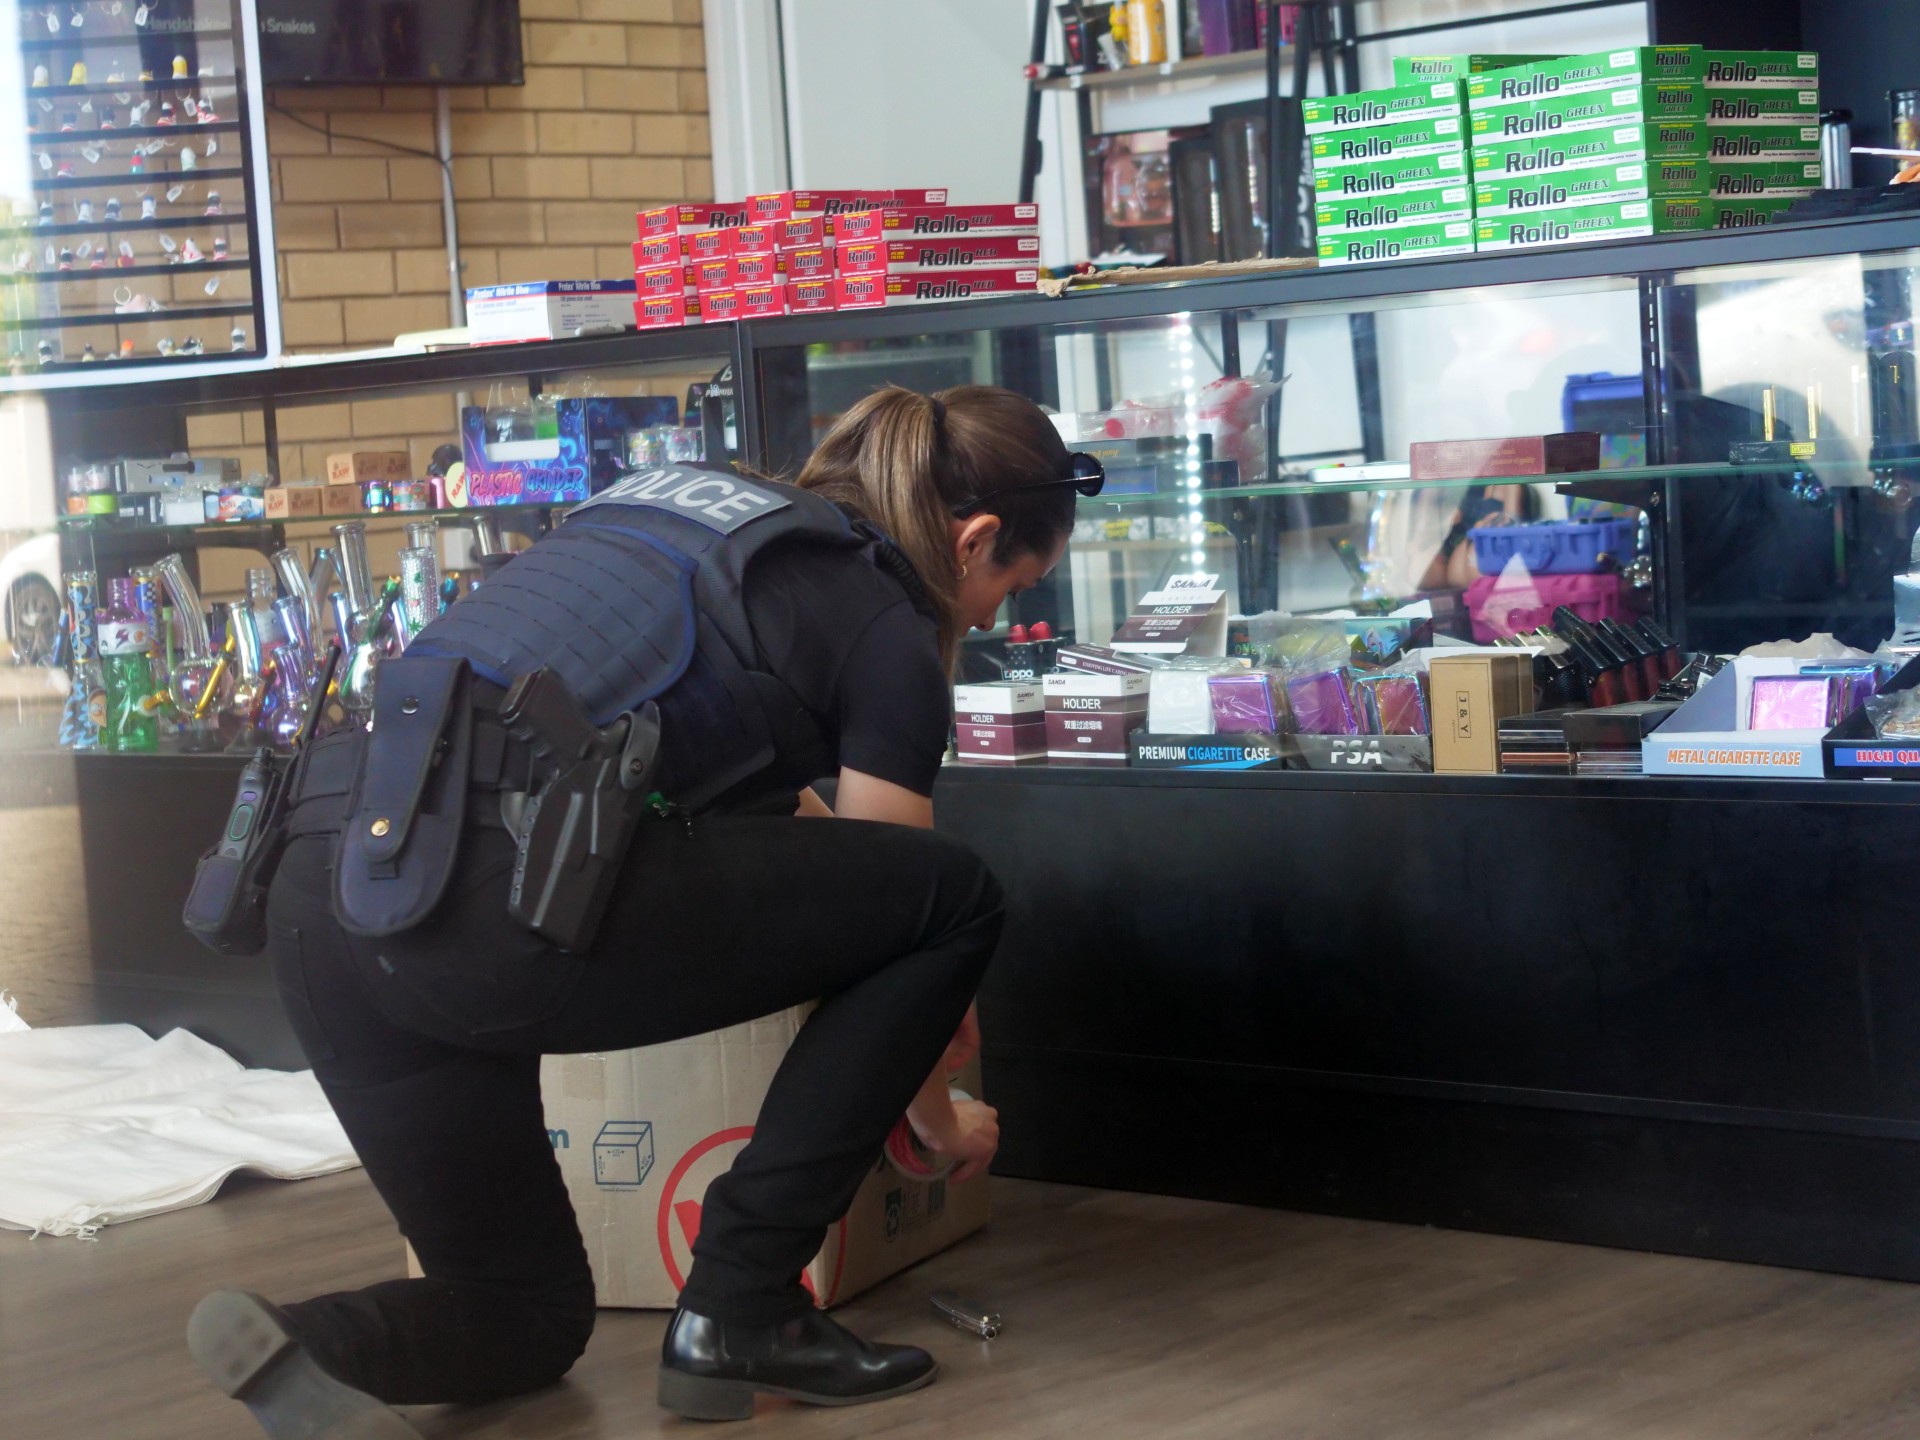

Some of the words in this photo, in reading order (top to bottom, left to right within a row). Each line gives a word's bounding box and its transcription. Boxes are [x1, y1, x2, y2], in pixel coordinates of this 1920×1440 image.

[267, 18, 316, 34] Snakes
[1656, 52, 1691, 66] Rollo
[1411, 62, 1453, 74] Rollo
[1708, 61, 1758, 83] Rollo
[1761, 63, 1792, 74] GREEN
[1500, 72, 1560, 100] Rollo
[1564, 65, 1604, 81] GREEN
[1657, 90, 1693, 104] Rollo
[1333, 101, 1387, 125] Rollo
[1390, 96, 1426, 109] GREEN
[1711, 98, 1760, 120] Rollo
[1763, 100, 1793, 110] GREEN
[1504, 110, 1563, 136] Rollo
[1566, 104, 1605, 118] GREEN
[1660, 129, 1695, 143] Rollo
[1340, 136, 1393, 160] Rollo
[1396, 132, 1430, 145] GREEN
[1712, 136, 1761, 157] Rollo
[1764, 137, 1796, 147] GREEN
[1505, 147, 1565, 173] Rollo
[1568, 142, 1608, 156] GREEN
[1343, 172, 1395, 195] Rollo
[1398, 167, 1433, 180] GREEN
[1662, 167, 1698, 181] Rollo
[1717, 174, 1765, 195] Rollo
[1768, 174, 1799, 184] GREEN
[1508, 184, 1567, 209] Rollo
[1571, 179, 1610, 192] GREEN
[756, 200, 781, 212] Rollo
[824, 198, 880, 215] Rollo
[1666, 205, 1700, 219] Rollo
[709, 212, 749, 229] Rol
[1346, 206, 1399, 228] Rollo
[1402, 200, 1437, 214] GREEN
[1719, 208, 1766, 230] Rollo
[646, 215, 668, 228] Rollo
[844, 218, 871, 231] Rollo
[913, 215, 970, 234] Rollo
[971, 216, 994, 224] RED
[786, 224, 813, 237] Rollo
[1510, 220, 1570, 245] Rollo
[1574, 217, 1614, 229] GREEN
[696, 237, 720, 249] Rollo
[739, 232, 764, 244] Rollo
[643, 244, 669, 256] Rollo
[1347, 239, 1401, 262] Rollo
[1405, 235, 1440, 248] GREEN
[795, 256, 823, 269] Rollo
[848, 251, 876, 264] Rollo
[919, 248, 974, 267] Rollo
[976, 249, 997, 257] RED
[703, 268, 727, 280] Rollo
[738, 262, 763, 274] Rollo
[576, 282, 590, 291] Nitrile
[591, 282, 602, 290] Blue
[646, 275, 672, 287] Rollo
[496, 287, 515, 297] Nitrile
[516, 286, 530, 295] Blue
[798, 288, 825, 300] Rollo
[846, 282, 874, 295] Rollo
[916, 281, 971, 300] Rollo
[974, 281, 995, 289] RED
[710, 298, 737, 311] Rollo
[747, 293, 773, 305] Rollo
[645, 304, 673, 317] Rollo
[332, 467, 350, 481] RAW
[470, 471, 523, 497] PLASTIC
[526, 468, 585, 494] GRINDER
[268, 499, 284, 512] RAW
[1152, 606, 1192, 614] HOLDER
[1063, 698, 1101, 710] HOLDER
[971, 714, 995, 724] HOLDER
[1460, 709, 1468, 718] &
[1461, 724, 1469, 733] Y
[1139, 746, 1186, 760] PREMIUM
[1188, 746, 1243, 761] CIGARETTE
[1244, 747, 1271, 761] CASE
[1330, 740, 1382, 765] PSA
[1667, 749, 1705, 765] METAL
[1707, 749, 1770, 766] CIGARETTE
[1772, 751, 1801, 766] CASE
[1856, 750, 1893, 763] HIGH
